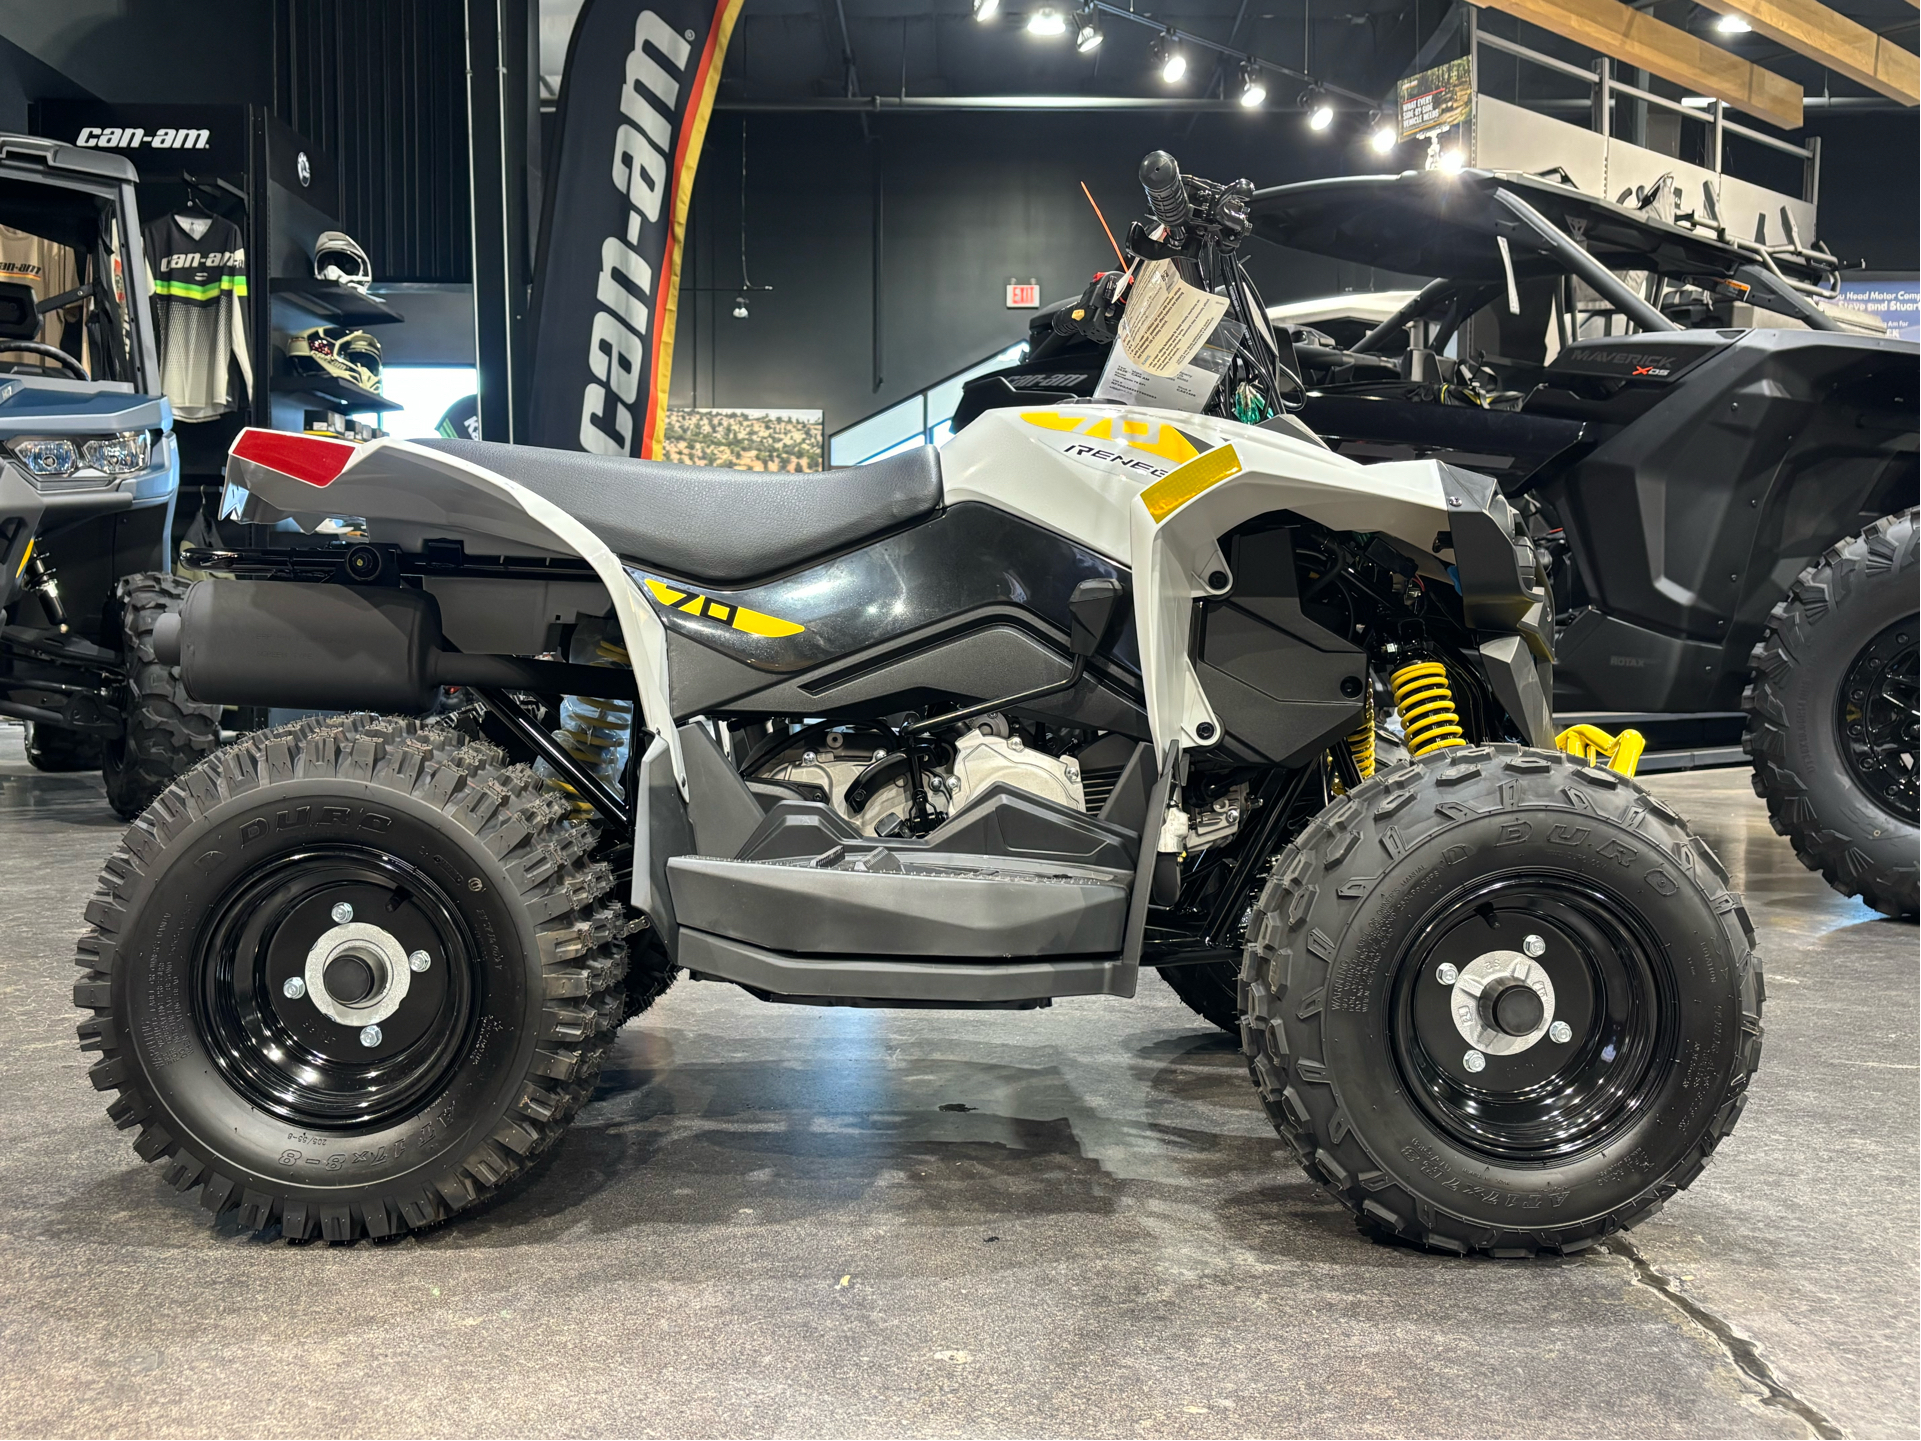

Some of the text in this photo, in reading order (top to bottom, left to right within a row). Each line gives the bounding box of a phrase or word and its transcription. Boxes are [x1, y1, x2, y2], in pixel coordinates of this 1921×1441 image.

[76, 127, 209, 149] can-am
[580, 9, 692, 457] can-am
[1012, 286, 1034, 304] EXIT
[1846, 291, 1869, 300] Head
[1870, 291, 1896, 300] Motor
[1839, 300, 1866, 311] Steve
[1867, 300, 1887, 311] and
[1570, 349, 1677, 369] MAVERICK
[1007, 374, 1088, 387] can-am
[665, 585, 739, 628] 70
[1609, 654, 1645, 668] ROTAX
[239, 805, 392, 849] DURO
[1492, 817, 1681, 897] DURO
[286, 1132, 327, 1146] 205/55-8
